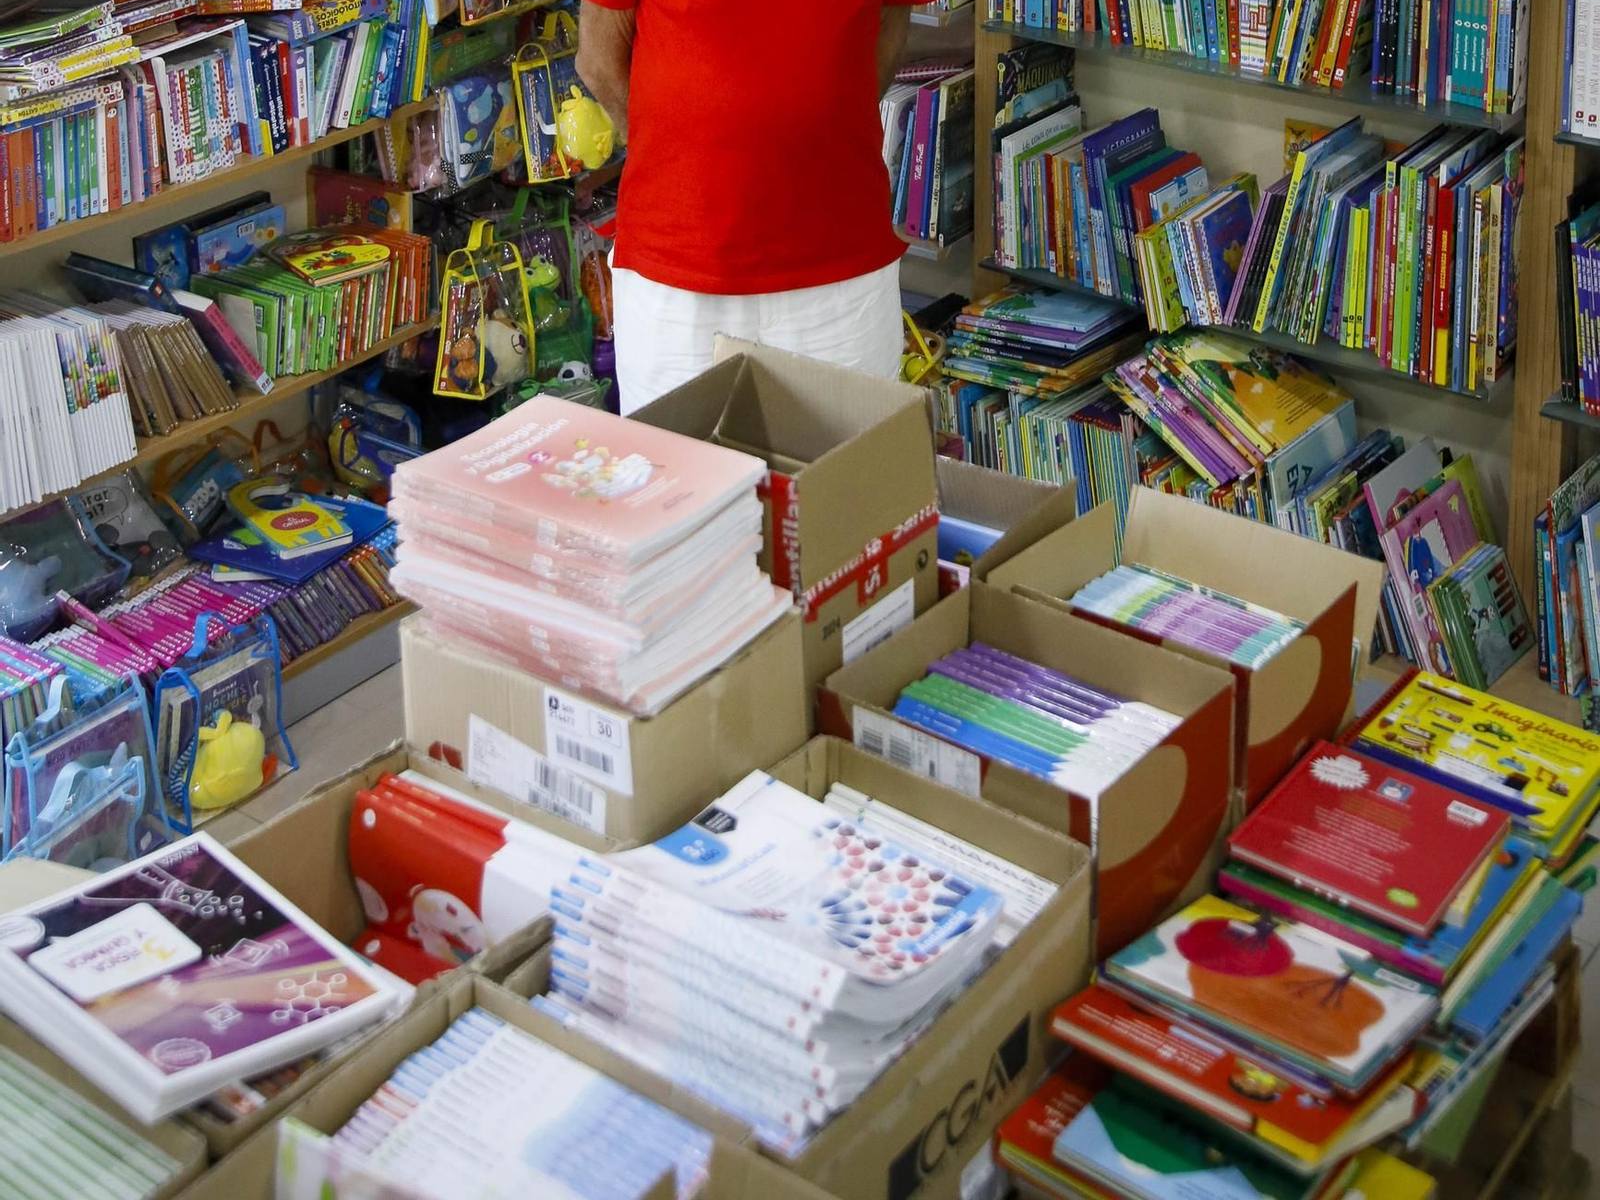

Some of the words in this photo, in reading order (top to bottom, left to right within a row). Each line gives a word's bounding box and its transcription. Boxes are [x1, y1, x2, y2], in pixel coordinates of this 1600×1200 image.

[317, 16, 338, 29] SERES
[269, 100, 279, 138] unicornio?
[276, 95, 286, 133] unicornio?
[1277, 215, 1288, 246] OCÉANO
[1288, 180, 1299, 205] CAPAS
[1426, 225, 1434, 255] PALABRAS
[1439, 253, 1447, 289] DICCIONARIO
[460, 422, 539, 463] Tecnología
[475, 418, 569, 472] Digitalización
[282, 518, 310, 529] ORINAL
[597, 720, 613, 738] 30
[1476, 700, 1600, 755] Imaginario
